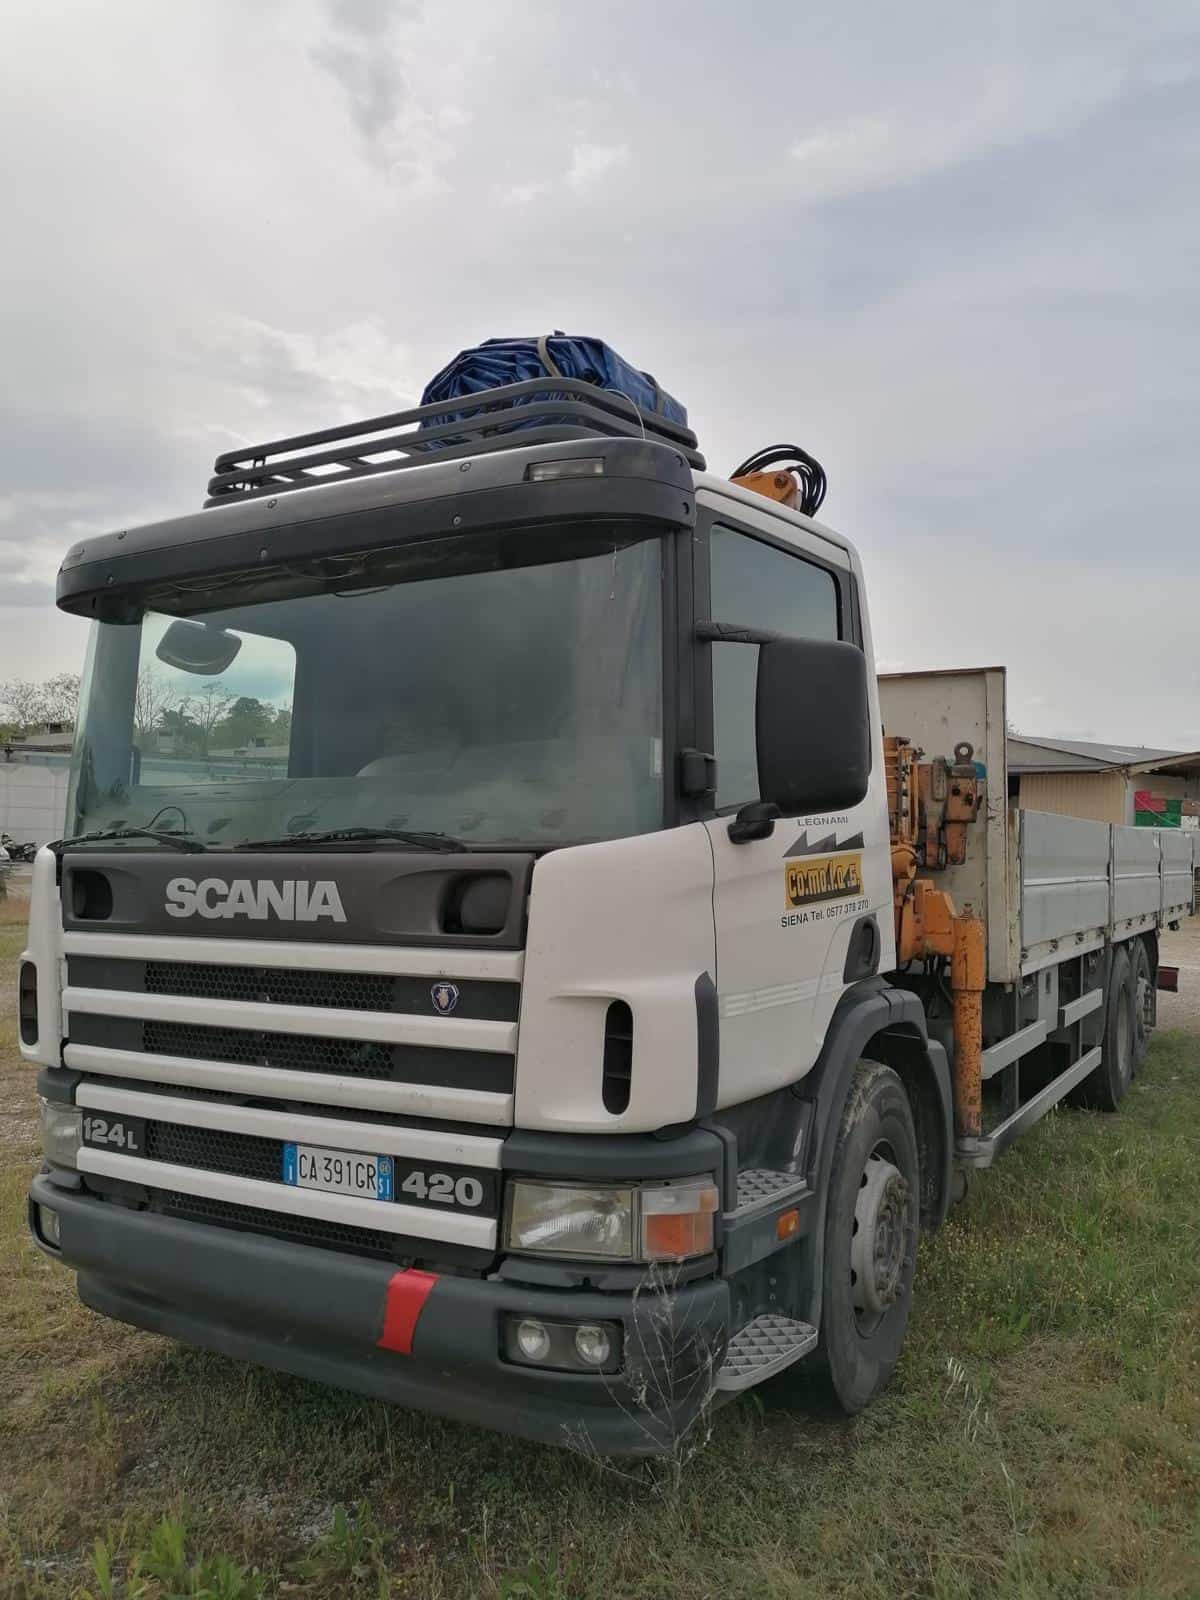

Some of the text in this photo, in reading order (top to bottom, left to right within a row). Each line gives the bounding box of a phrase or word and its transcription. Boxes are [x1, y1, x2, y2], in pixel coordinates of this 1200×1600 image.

[797, 816, 849, 827] LEGNAMI
[165, 877, 348, 922] SCANIA
[781, 912, 809, 928] SIENA
[811, 909, 825, 921] Tel.
[826, 904, 843, 917] 0577
[401, 1171, 484, 1207] 420
